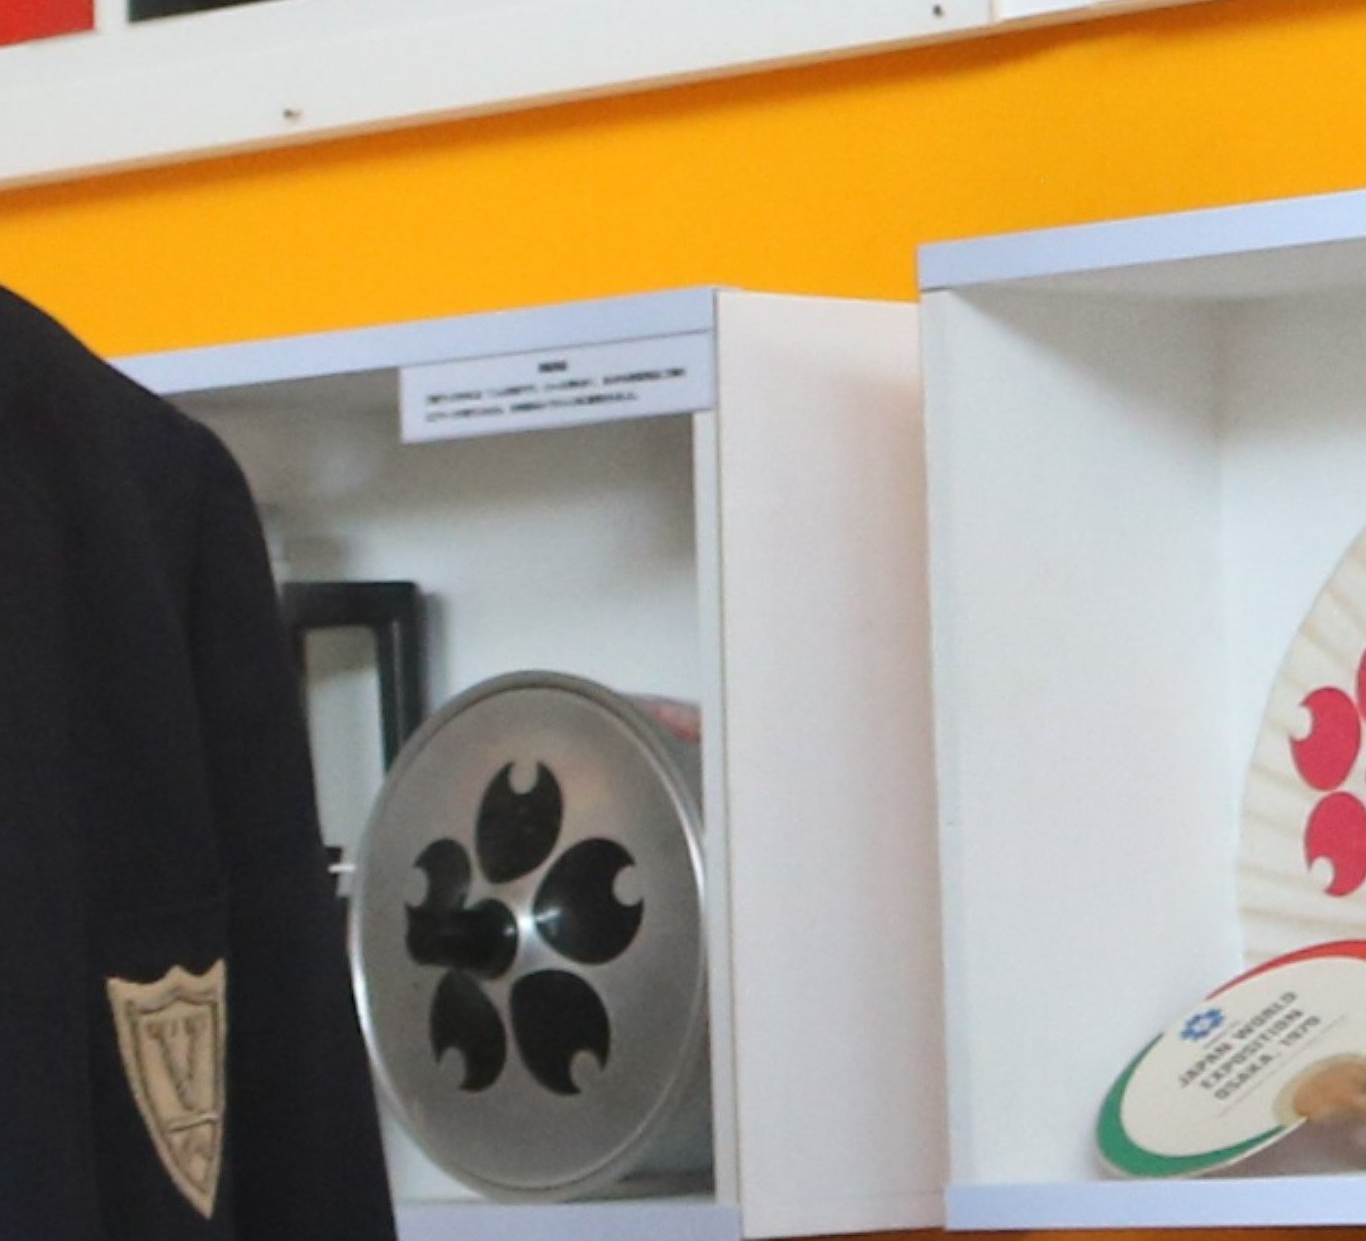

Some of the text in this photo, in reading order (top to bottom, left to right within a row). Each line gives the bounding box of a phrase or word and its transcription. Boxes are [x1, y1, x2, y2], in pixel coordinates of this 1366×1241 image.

[1178, 1042, 1233, 1088] JAPAN
[1232, 991, 1297, 1040] WORLD
[1200, 1009, 1304, 1090] EXPOSITION
[1278, 1015, 1322, 1046] 1970
